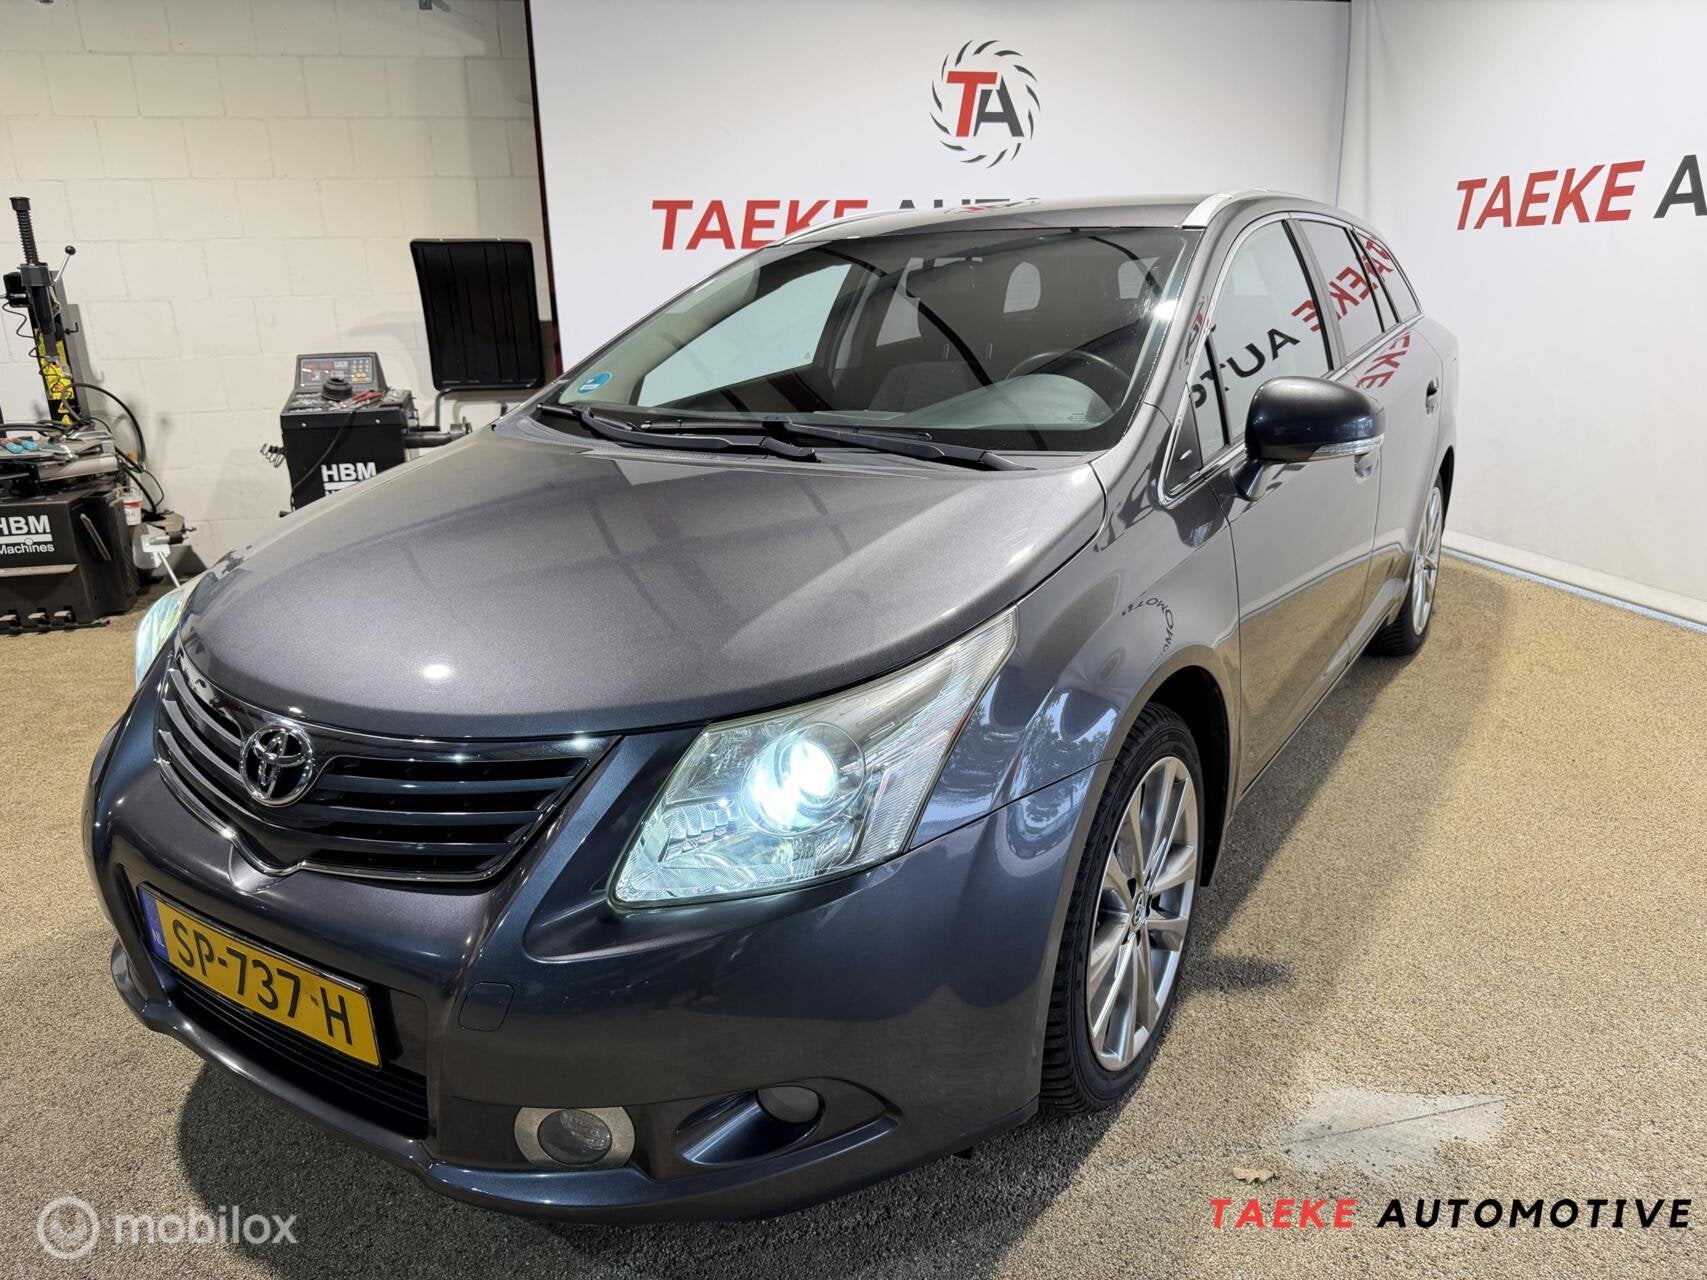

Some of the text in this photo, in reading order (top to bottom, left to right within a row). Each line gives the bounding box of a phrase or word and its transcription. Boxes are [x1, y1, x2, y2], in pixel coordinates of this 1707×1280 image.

[946, 71, 1025, 137] TA
[1456, 154, 1707, 231] TAEKE A
[321, 461, 377, 483] HBM
[151, 927, 166, 948] NL
[172, 919, 353, 1046] SP-737-H
